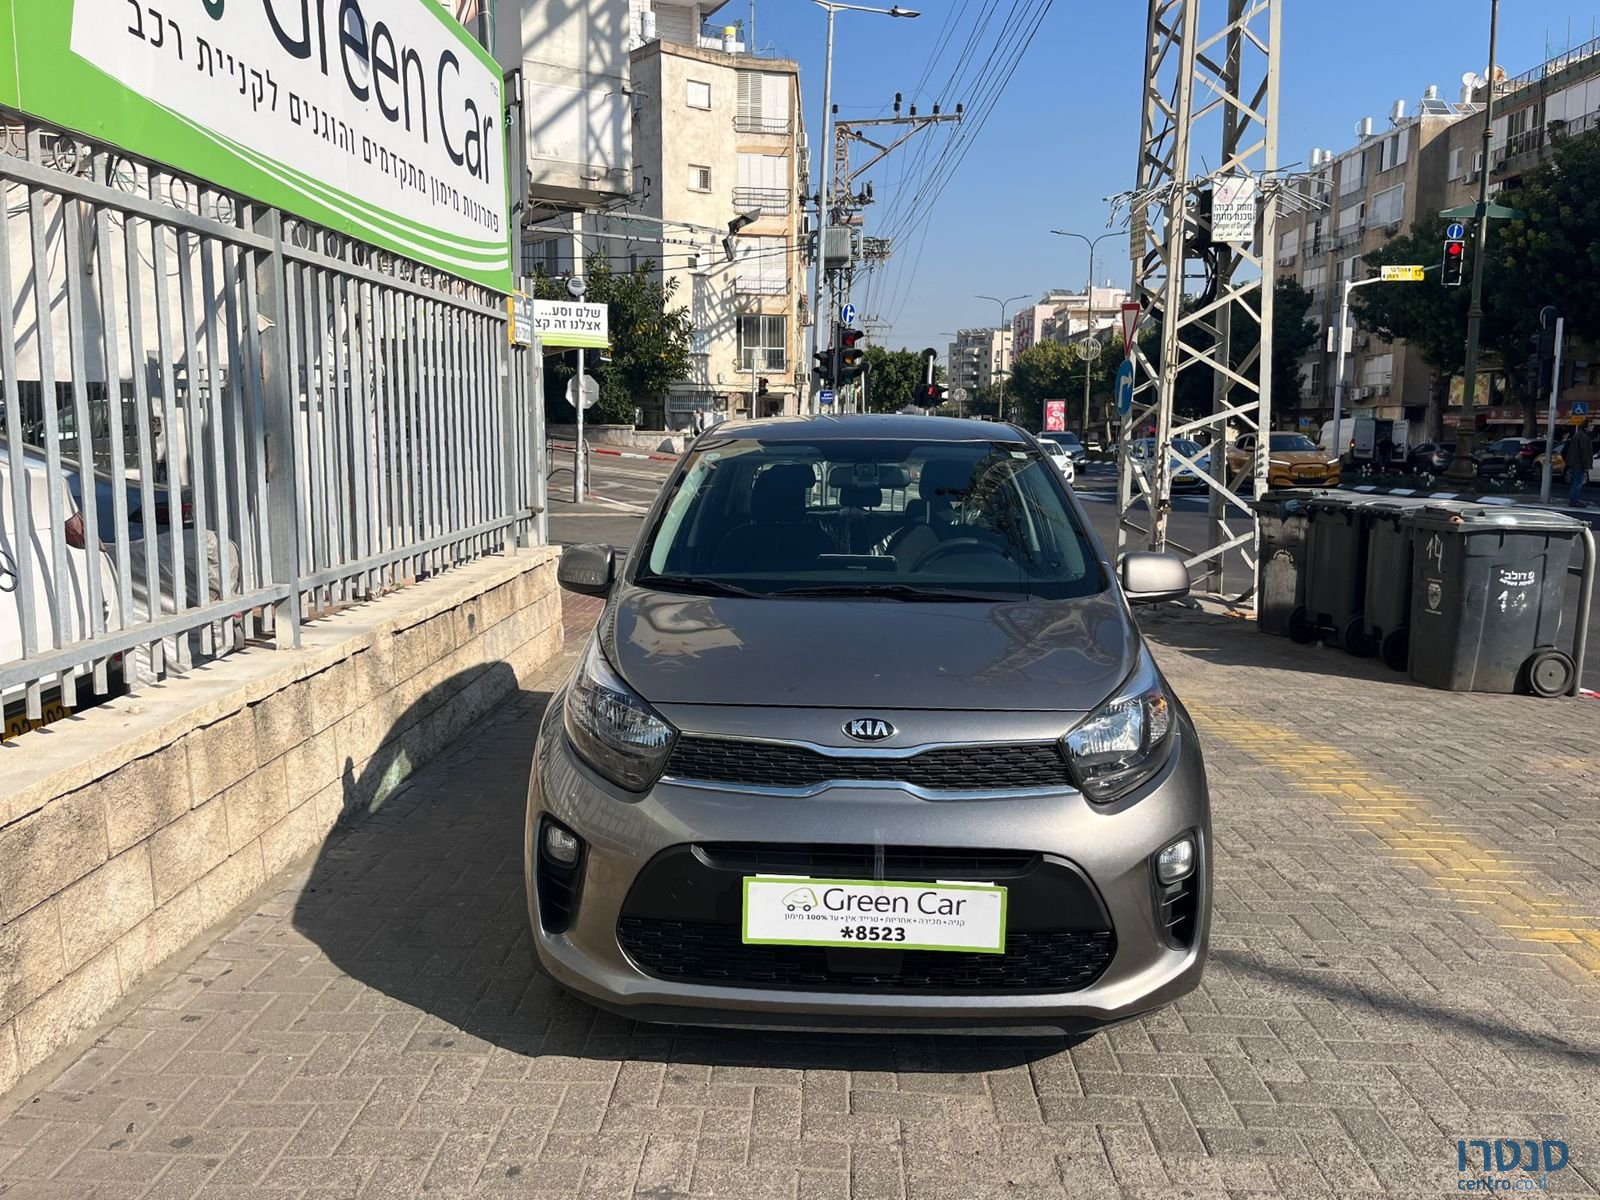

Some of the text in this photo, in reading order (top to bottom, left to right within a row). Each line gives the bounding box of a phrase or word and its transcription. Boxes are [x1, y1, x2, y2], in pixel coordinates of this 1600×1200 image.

[127, 0, 499, 233] פתרונות מימון מתקדמים והוגנים לקניית רכב
[437, 49, 493, 184] Car
[540, 306, 572, 317] וסע...
[576, 306, 601, 318] שלם
[554, 319, 567, 329] זה
[571, 318, 601, 331] אצלנו
[1504, 570, 1528, 580] דולב
[851, 720, 889, 736] KIA
[823, 887, 967, 916] Green Car
[784, 913, 804, 921] מימון
[845, 915, 857, 923] אין
[860, 915, 879, 923] טרייד
[885, 916, 911, 925] אחריות
[918, 917, 942, 926] מכירה
[948, 919, 965, 927] קניה
